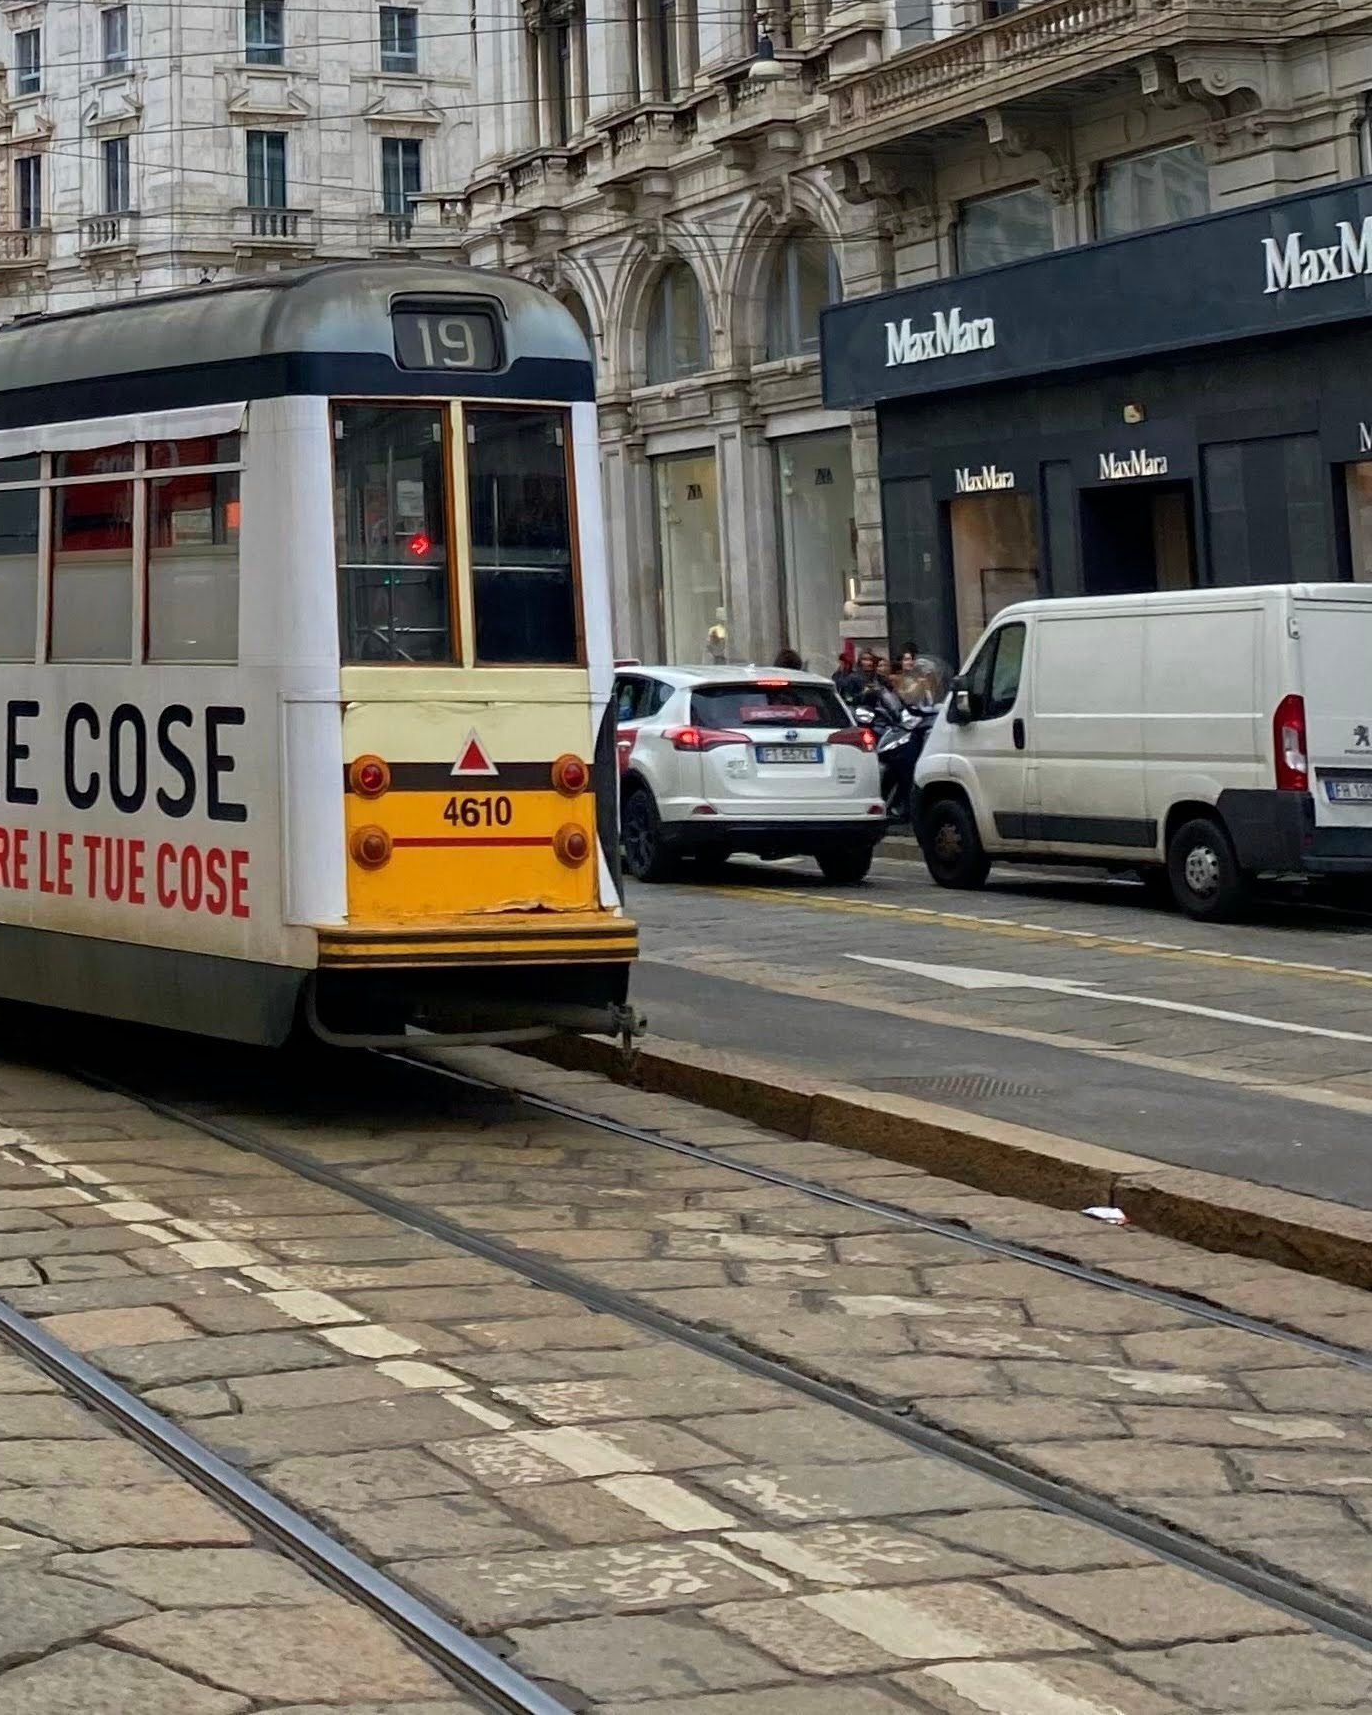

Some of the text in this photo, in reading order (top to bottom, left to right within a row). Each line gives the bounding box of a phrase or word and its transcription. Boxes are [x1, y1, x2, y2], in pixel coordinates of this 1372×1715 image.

[417, 318, 476, 366] 19
[885, 307, 995, 367] MaxMara
[955, 465, 1014, 493] MaxMara
[1099, 449, 1168, 480] MaxMara
[64, 702, 248, 822] COSE
[443, 796, 512, 827] 4610
[39, 831, 73, 895] LE
[83, 835, 146, 905] TUE
[156, 841, 250, 919] COSE
